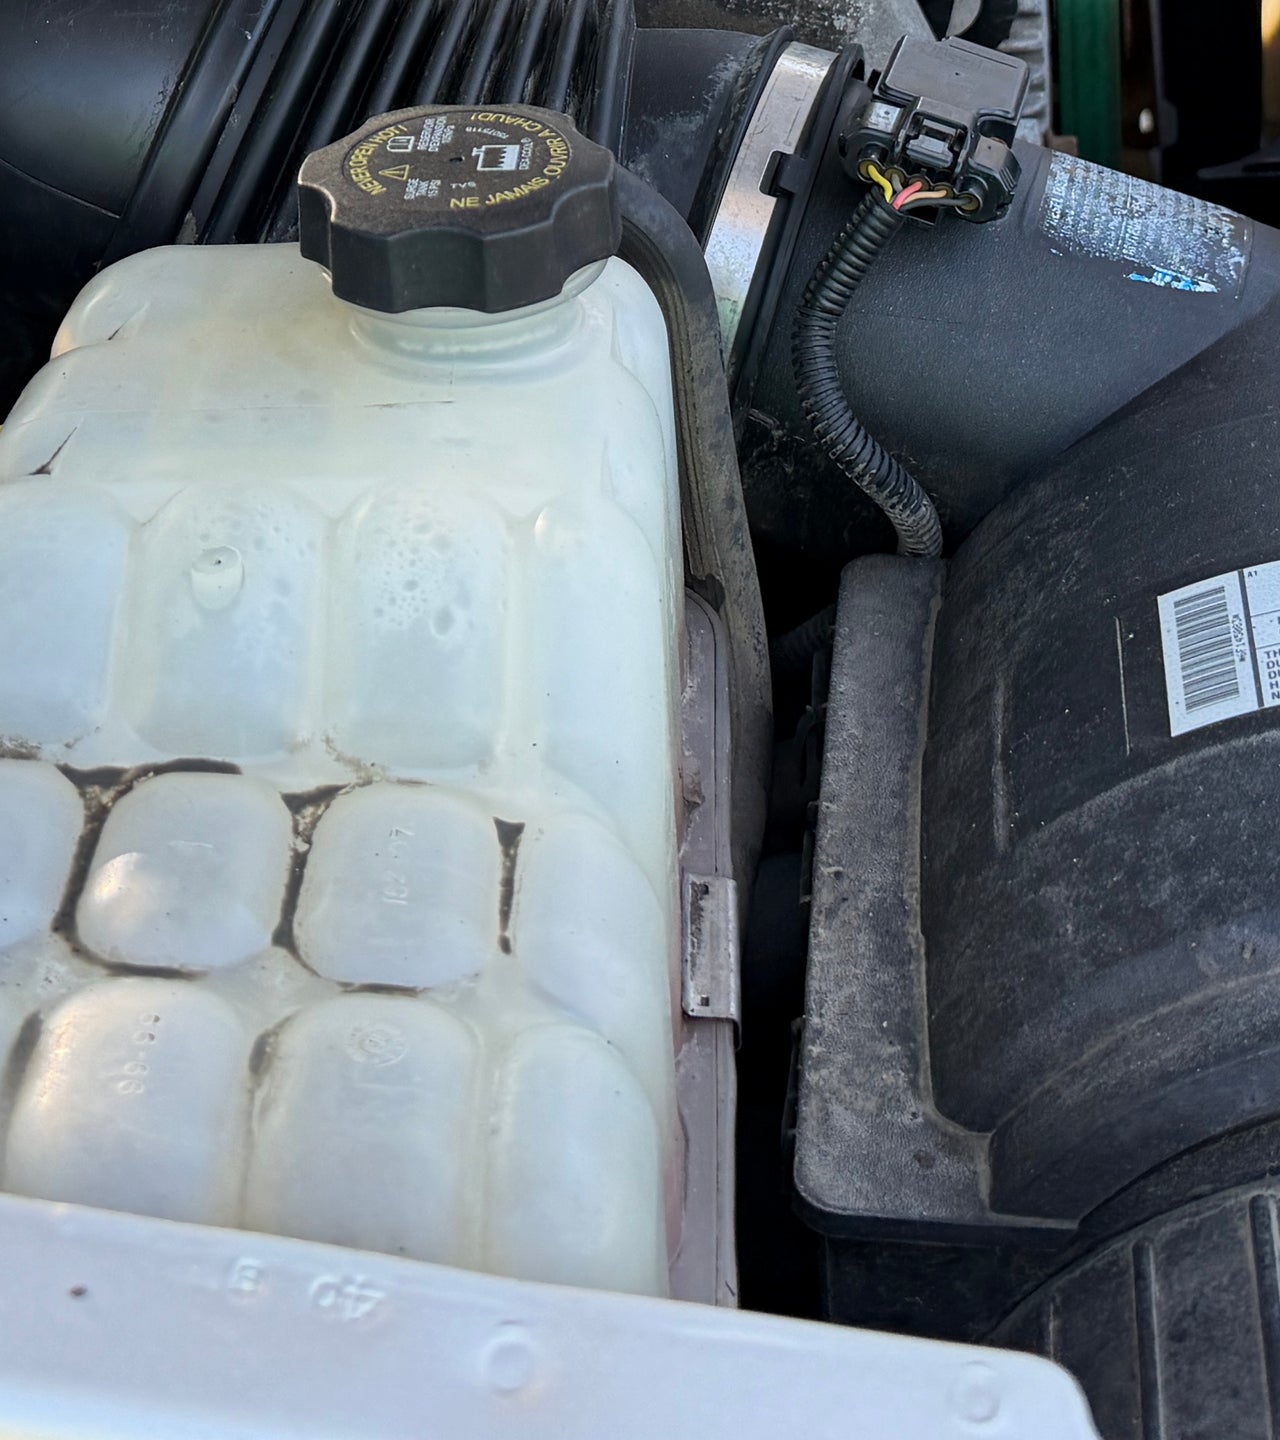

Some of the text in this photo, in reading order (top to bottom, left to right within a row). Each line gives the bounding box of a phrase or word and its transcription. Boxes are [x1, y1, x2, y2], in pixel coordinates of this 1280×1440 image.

[349, 142, 379, 167] OPEN
[351, 166, 387, 196] NEVER
[449, 196, 480, 209] NE
[485, 176, 550, 205] JAMAIS
